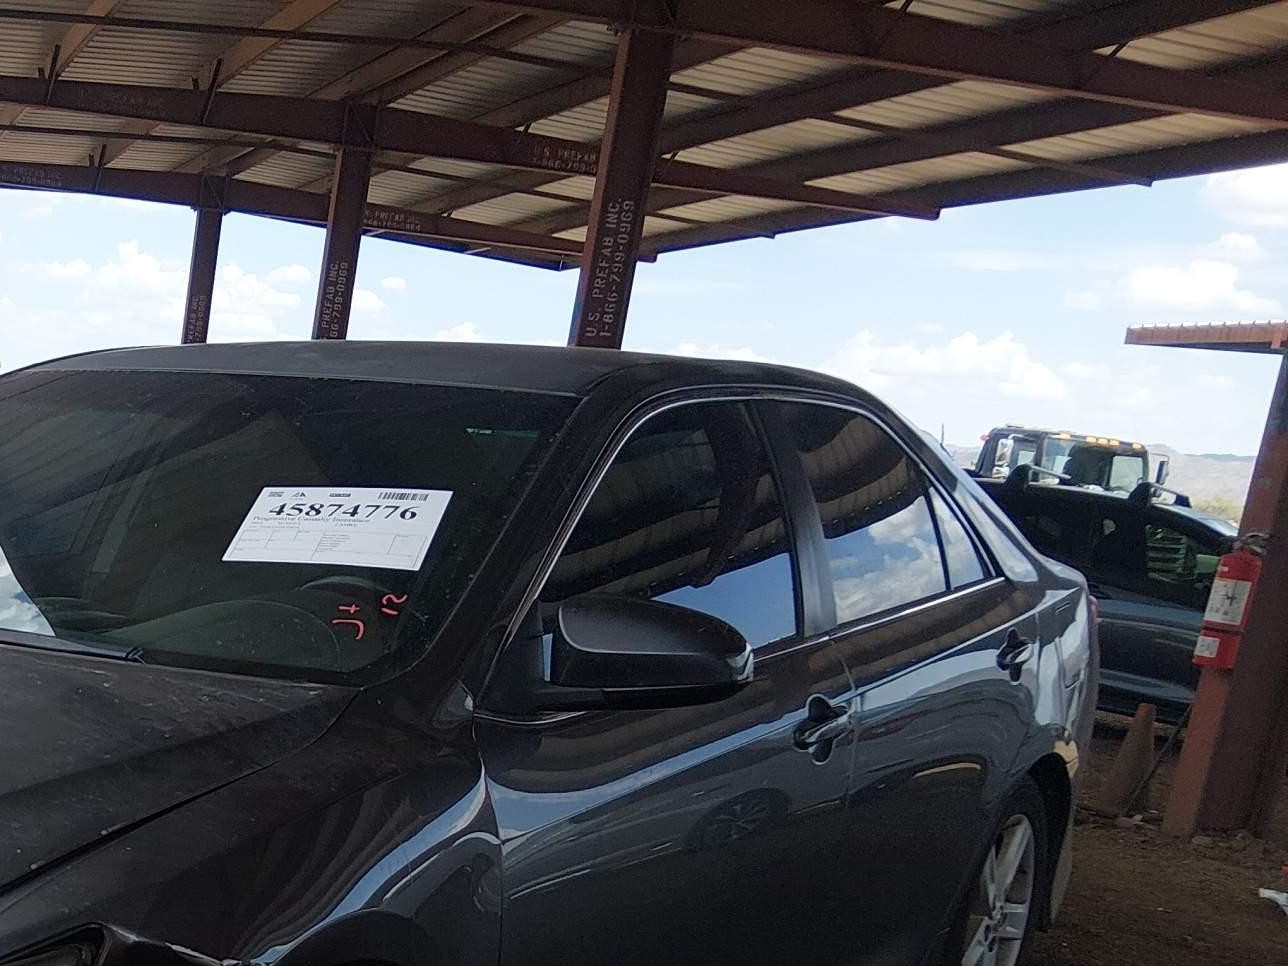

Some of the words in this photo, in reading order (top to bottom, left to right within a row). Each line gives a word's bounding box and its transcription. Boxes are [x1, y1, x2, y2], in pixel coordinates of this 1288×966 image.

[592, 238, 614, 298] PREFAB
[606, 198, 622, 228] INC.
[600, 200, 634, 337] 1-866-799-0969
[321, 286, 335, 328] PREFAB
[269, 502, 421, 521] 45874776
